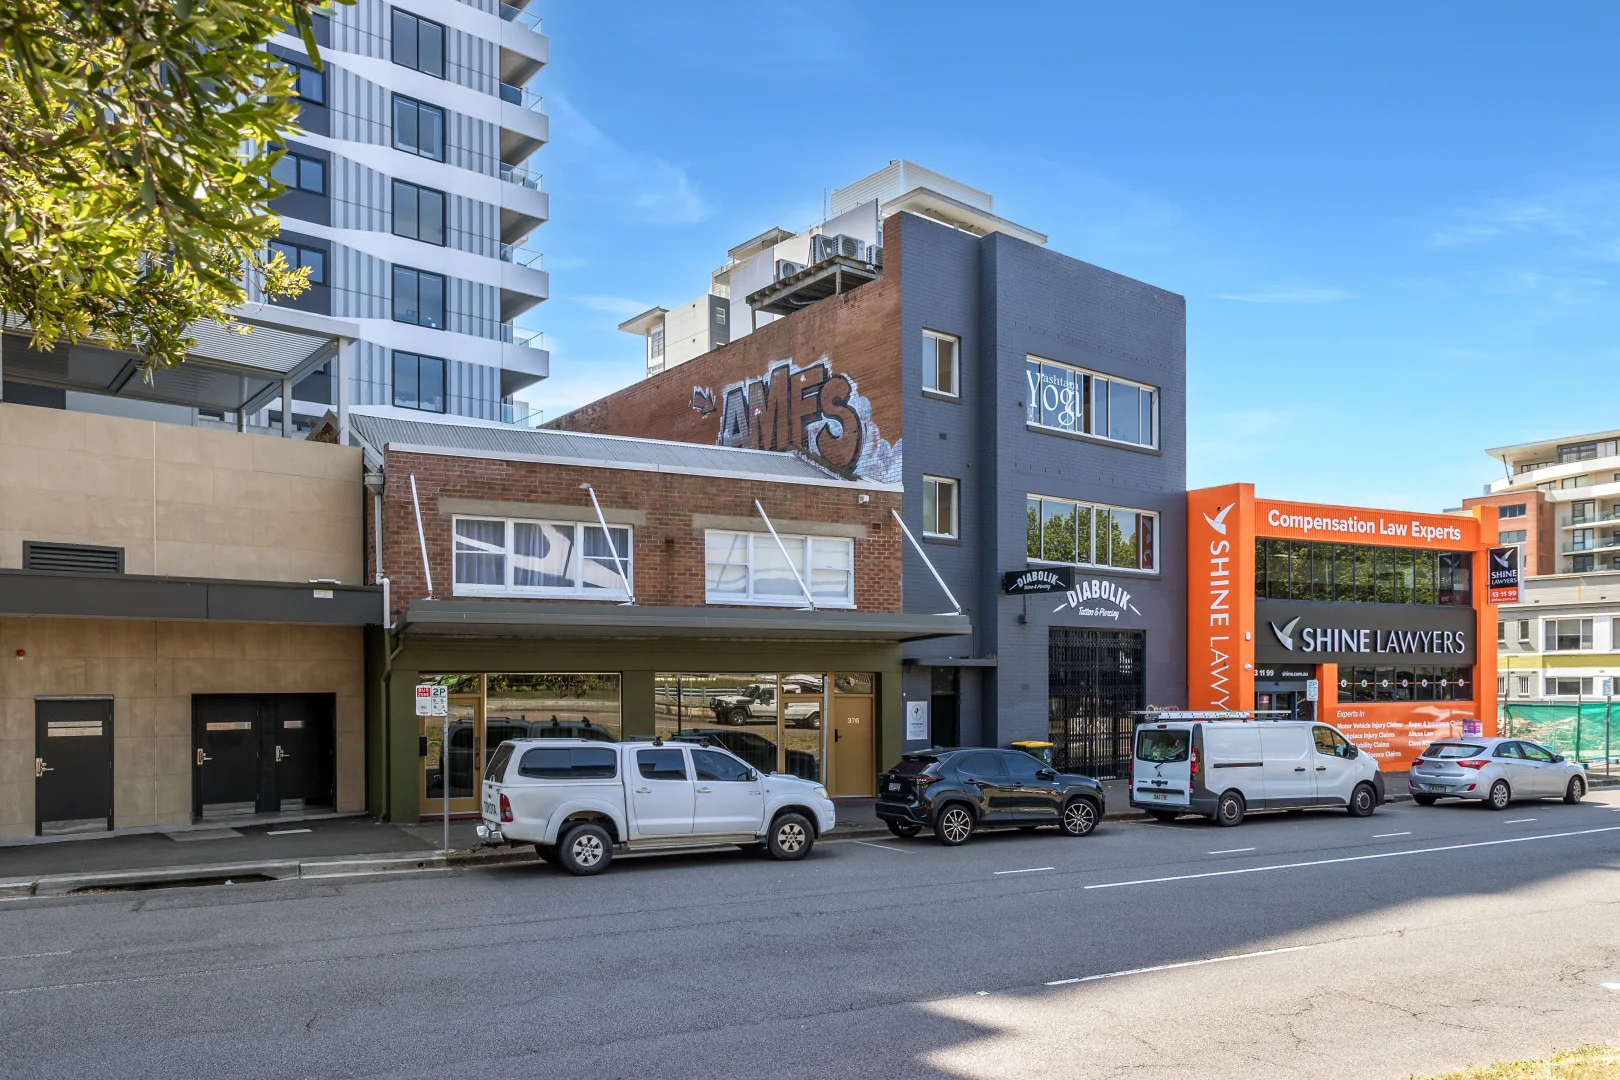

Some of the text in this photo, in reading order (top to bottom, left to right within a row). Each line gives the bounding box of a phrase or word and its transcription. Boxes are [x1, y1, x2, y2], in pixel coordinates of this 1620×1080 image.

[1026, 370, 1083, 425] Yoga
[1268, 509, 1461, 542] Compensation Law Experts
[1017, 571, 1058, 588] DIABOLIK
[1491, 570, 1517, 579] SHINE
[1066, 580, 1130, 611] DIABOLIK
[1078, 606, 1119, 620] Tattoo & Piercing
[1210, 540, 1230, 711] SHINE LAWY
[1302, 627, 1465, 654] SHINE LAWYERS
[433, 688, 446, 696] 2P
[1336, 710, 1358, 718] Experts
[1372, 722, 1386, 730] Injury
[1408, 720, 1423, 728] Super
